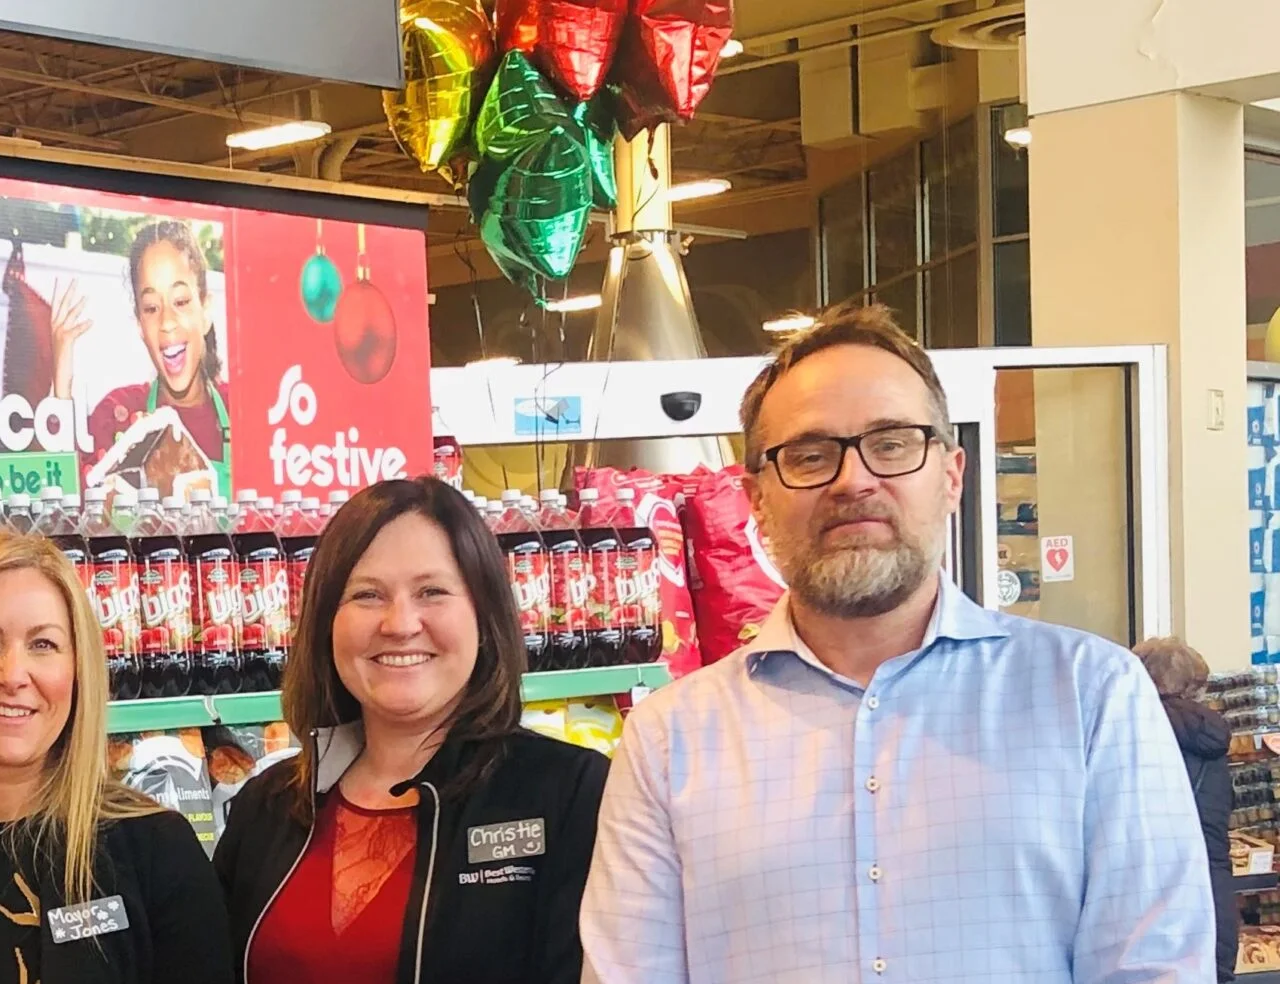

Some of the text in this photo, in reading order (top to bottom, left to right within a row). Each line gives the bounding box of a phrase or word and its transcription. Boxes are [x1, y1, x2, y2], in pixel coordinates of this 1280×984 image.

[268, 364, 317, 426] So
[269, 426, 408, 487] festive
[9, 464, 41, 494] be
[46, 461, 62, 487] it
[1046, 538, 1069, 548] AED
[470, 822, 541, 847] Christie
[492, 844, 516, 858] GM
[69, 919, 119, 940] Jones
